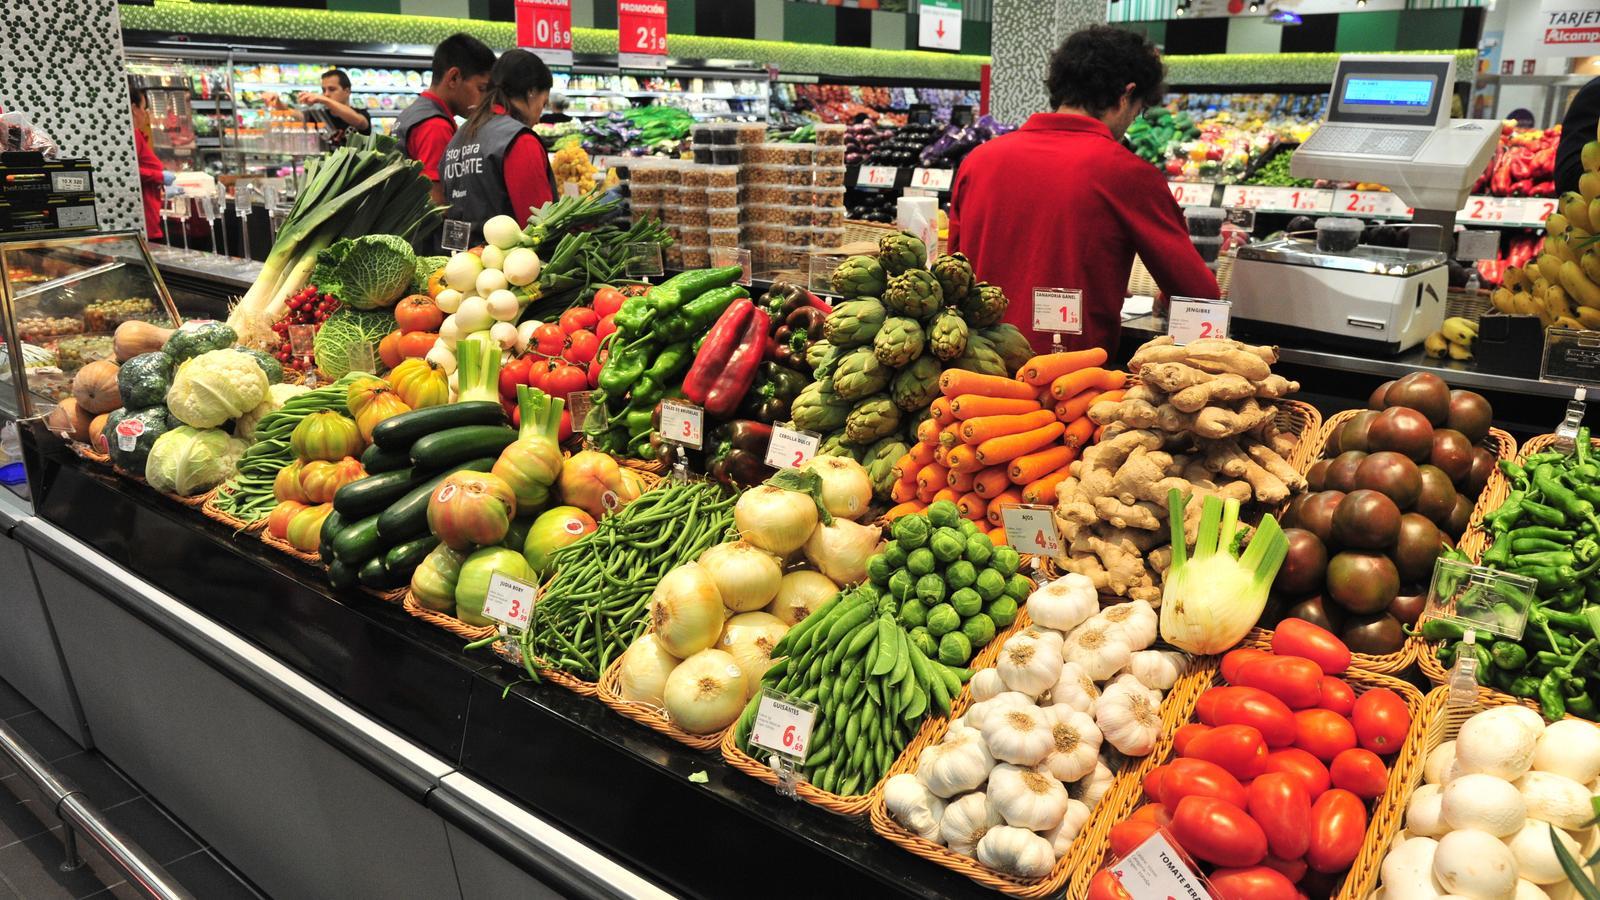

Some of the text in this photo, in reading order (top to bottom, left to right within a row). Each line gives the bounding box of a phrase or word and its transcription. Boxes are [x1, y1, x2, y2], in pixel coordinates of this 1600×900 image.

[620, 3, 664, 14] PROMOCIÓN
[1546, 30, 1600, 43] Alcamp
[462, 143, 480, 159] para
[1186, 306, 1211, 314] JENGIBRE
[779, 432, 811, 446] CEBOLLA DULCE
[773, 701, 799, 716] GUISANTES
[1159, 851, 1186, 884] TOMATE
